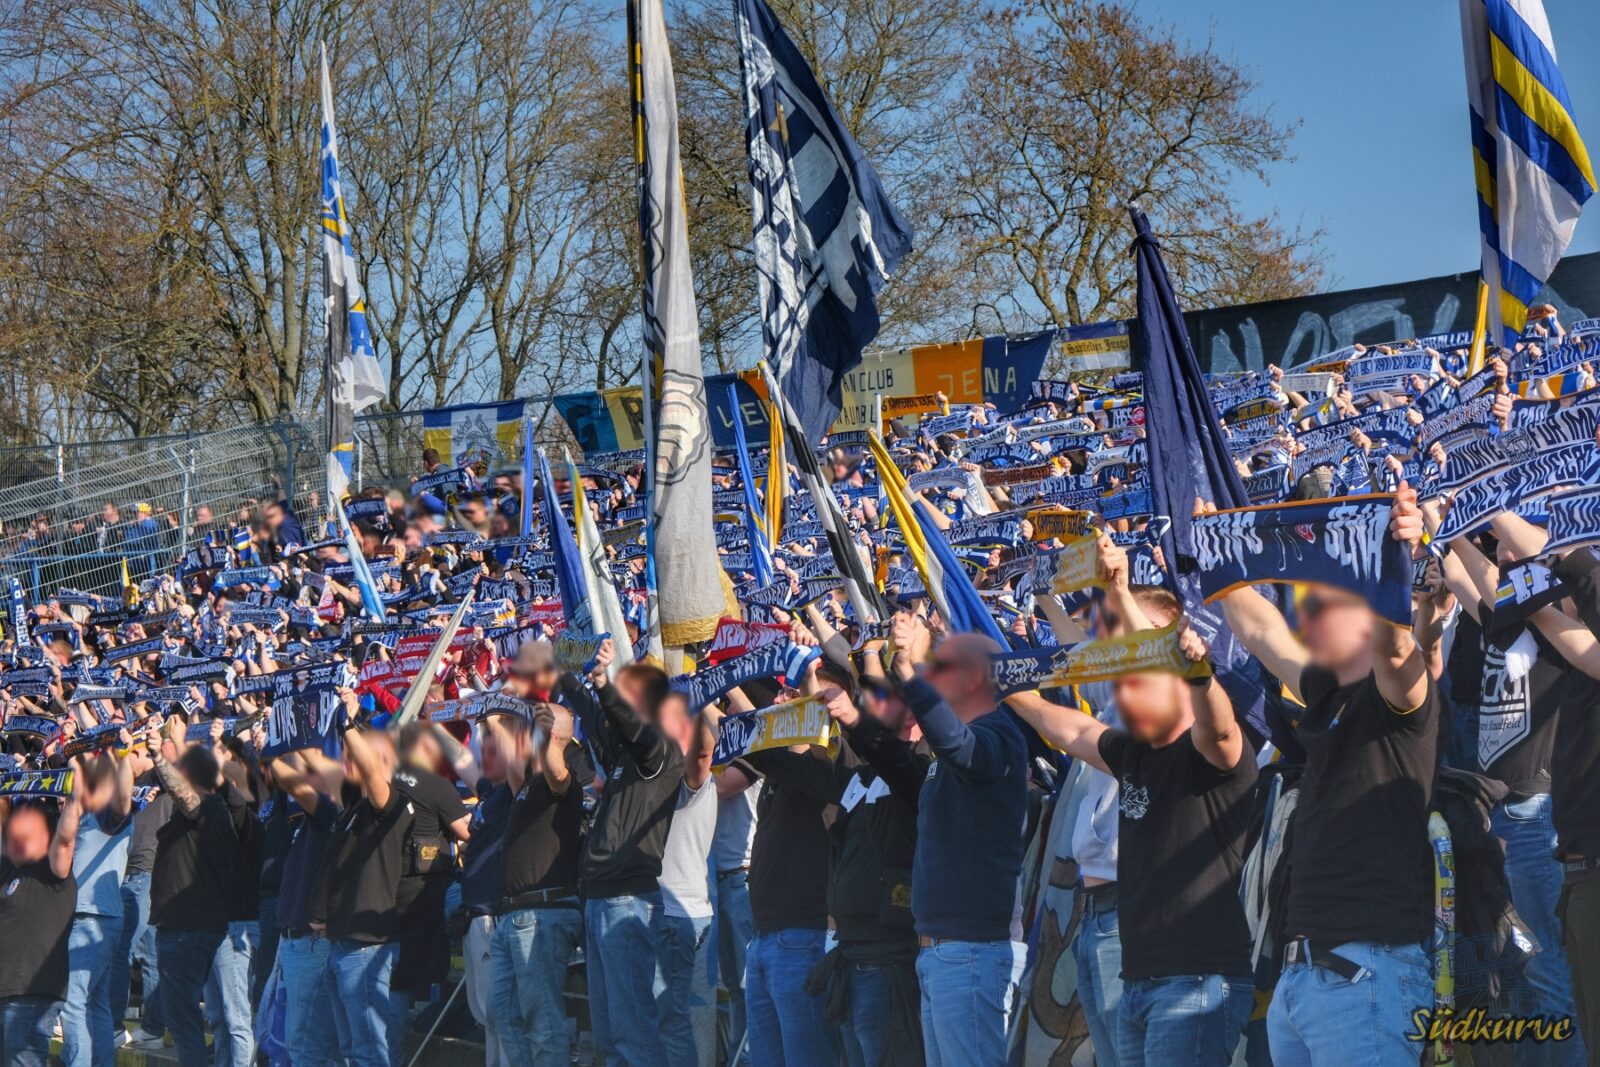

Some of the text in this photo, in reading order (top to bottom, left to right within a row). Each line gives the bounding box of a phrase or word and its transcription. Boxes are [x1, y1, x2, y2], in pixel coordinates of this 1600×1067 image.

[842, 368, 893, 393] ANCLUB
[938, 366, 1017, 401] JENA
[965, 438, 987, 448] ZEISS
[1015, 430, 1031, 441] ARL
[1069, 420, 1085, 430] JEN
[1527, 414, 1568, 449] FÜR
